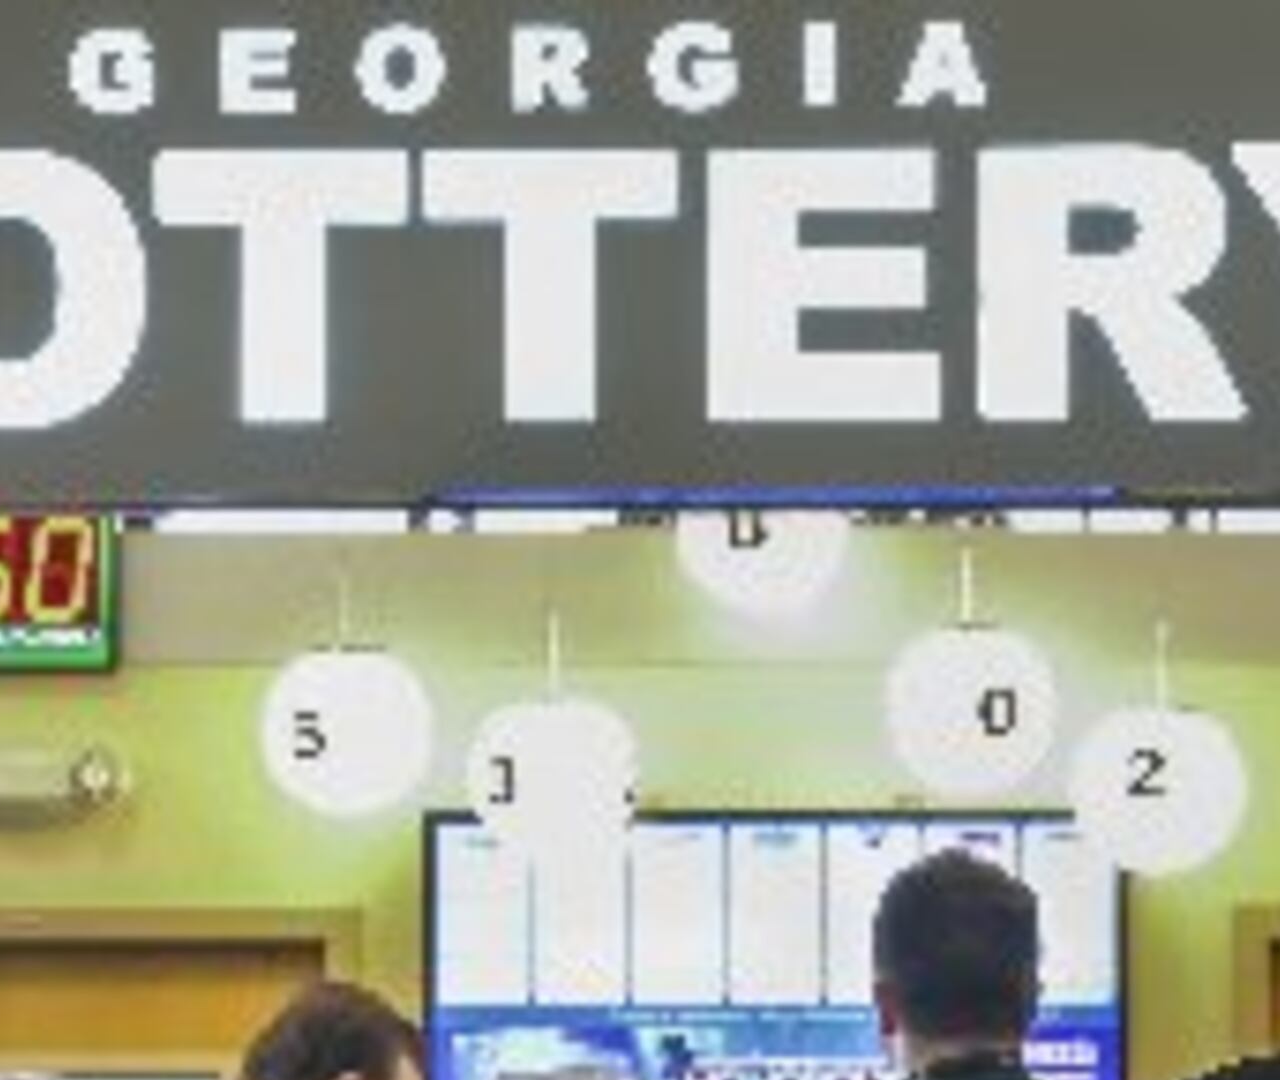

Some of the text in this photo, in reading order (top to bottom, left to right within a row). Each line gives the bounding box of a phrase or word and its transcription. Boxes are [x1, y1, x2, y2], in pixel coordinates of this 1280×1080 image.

[68, 20, 987, 115] GEORGIA
[294, 711, 327, 759] 5
[1126, 748, 1166, 797] 2
